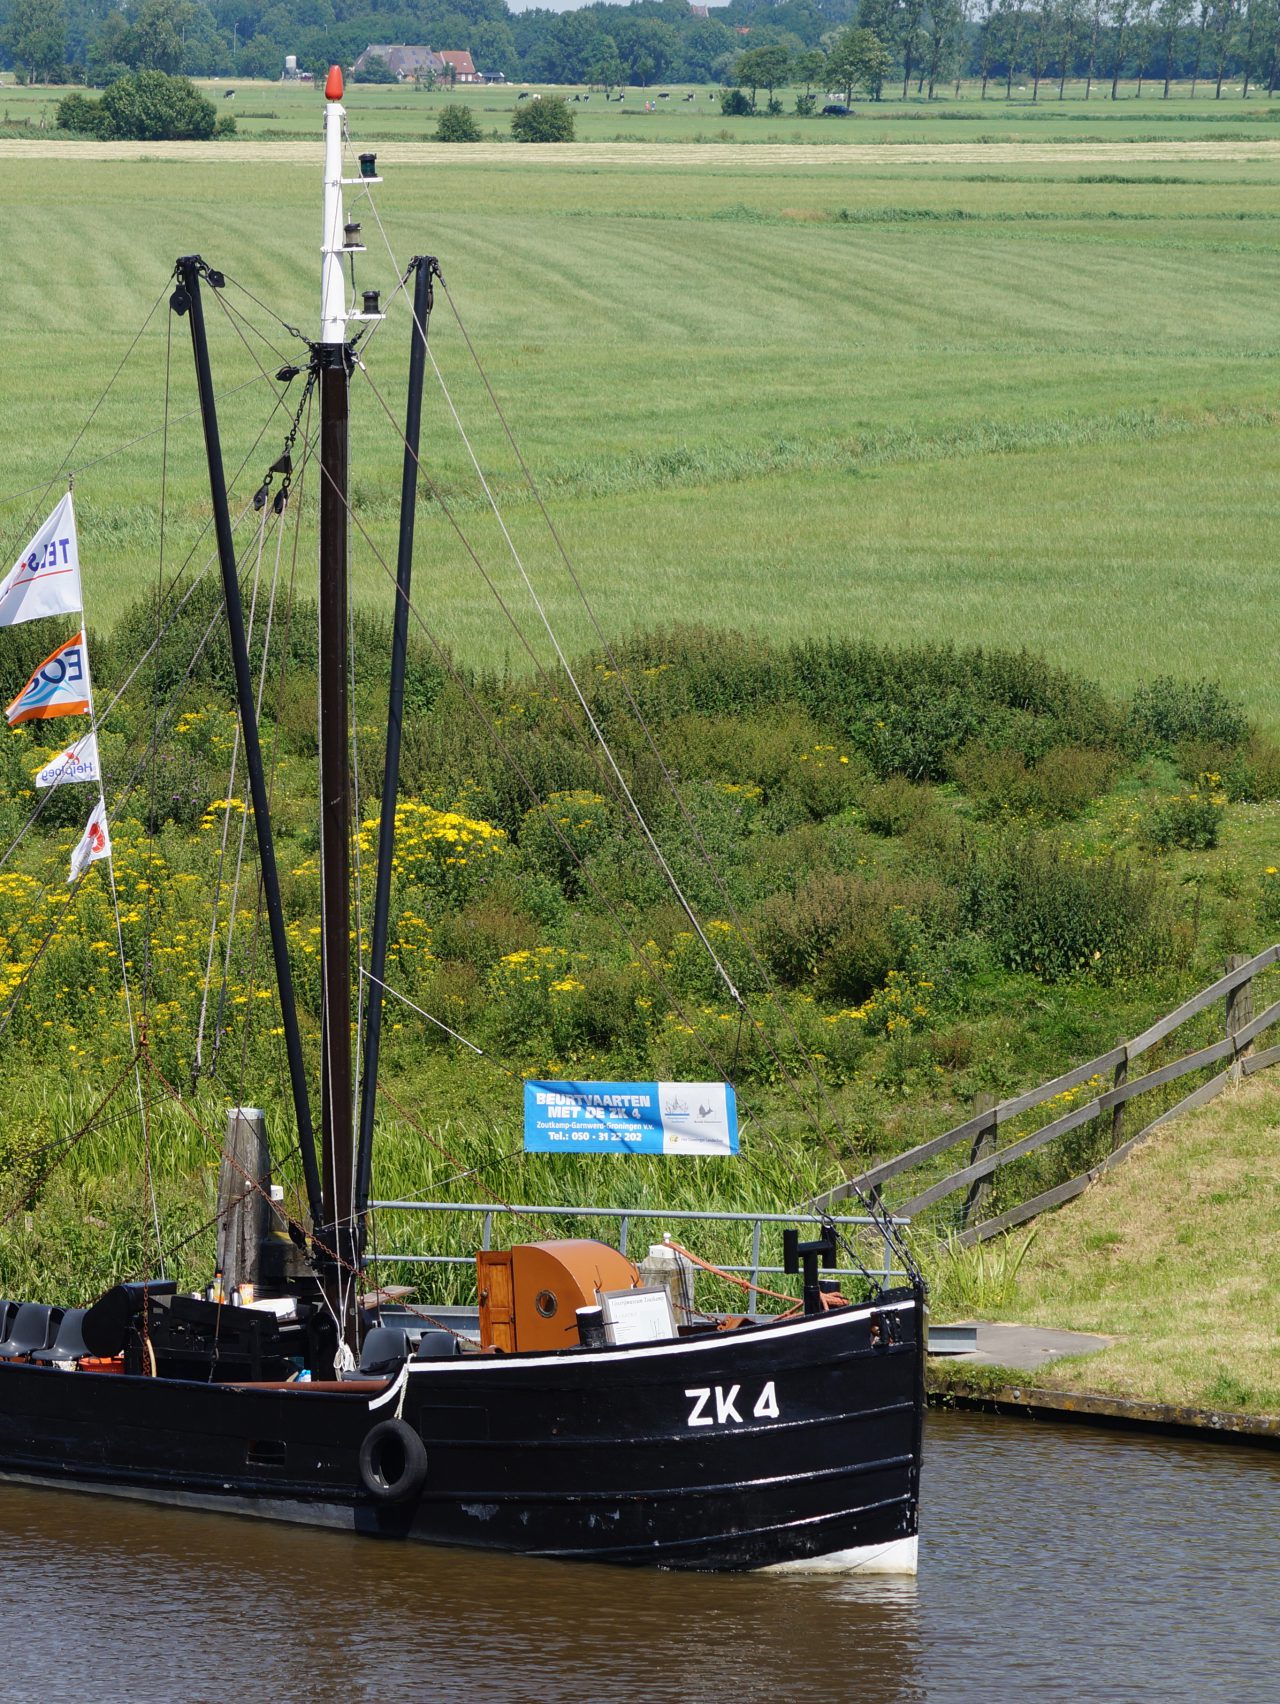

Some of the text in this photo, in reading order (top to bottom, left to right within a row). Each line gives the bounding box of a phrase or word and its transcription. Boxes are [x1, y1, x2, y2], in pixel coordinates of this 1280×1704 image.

[536, 1092, 651, 1107] BEURTVAARTEN
[548, 1106, 641, 1119] MET DE ZK 4
[548, 1131, 569, 1140] Tel.:
[572, 1132, 589, 1141] 050
[598, 1132, 608, 1141] 31
[611, 1132, 622, 1141] 22
[625, 1132, 642, 1141] 202
[685, 1381, 780, 1427] ZK 4
